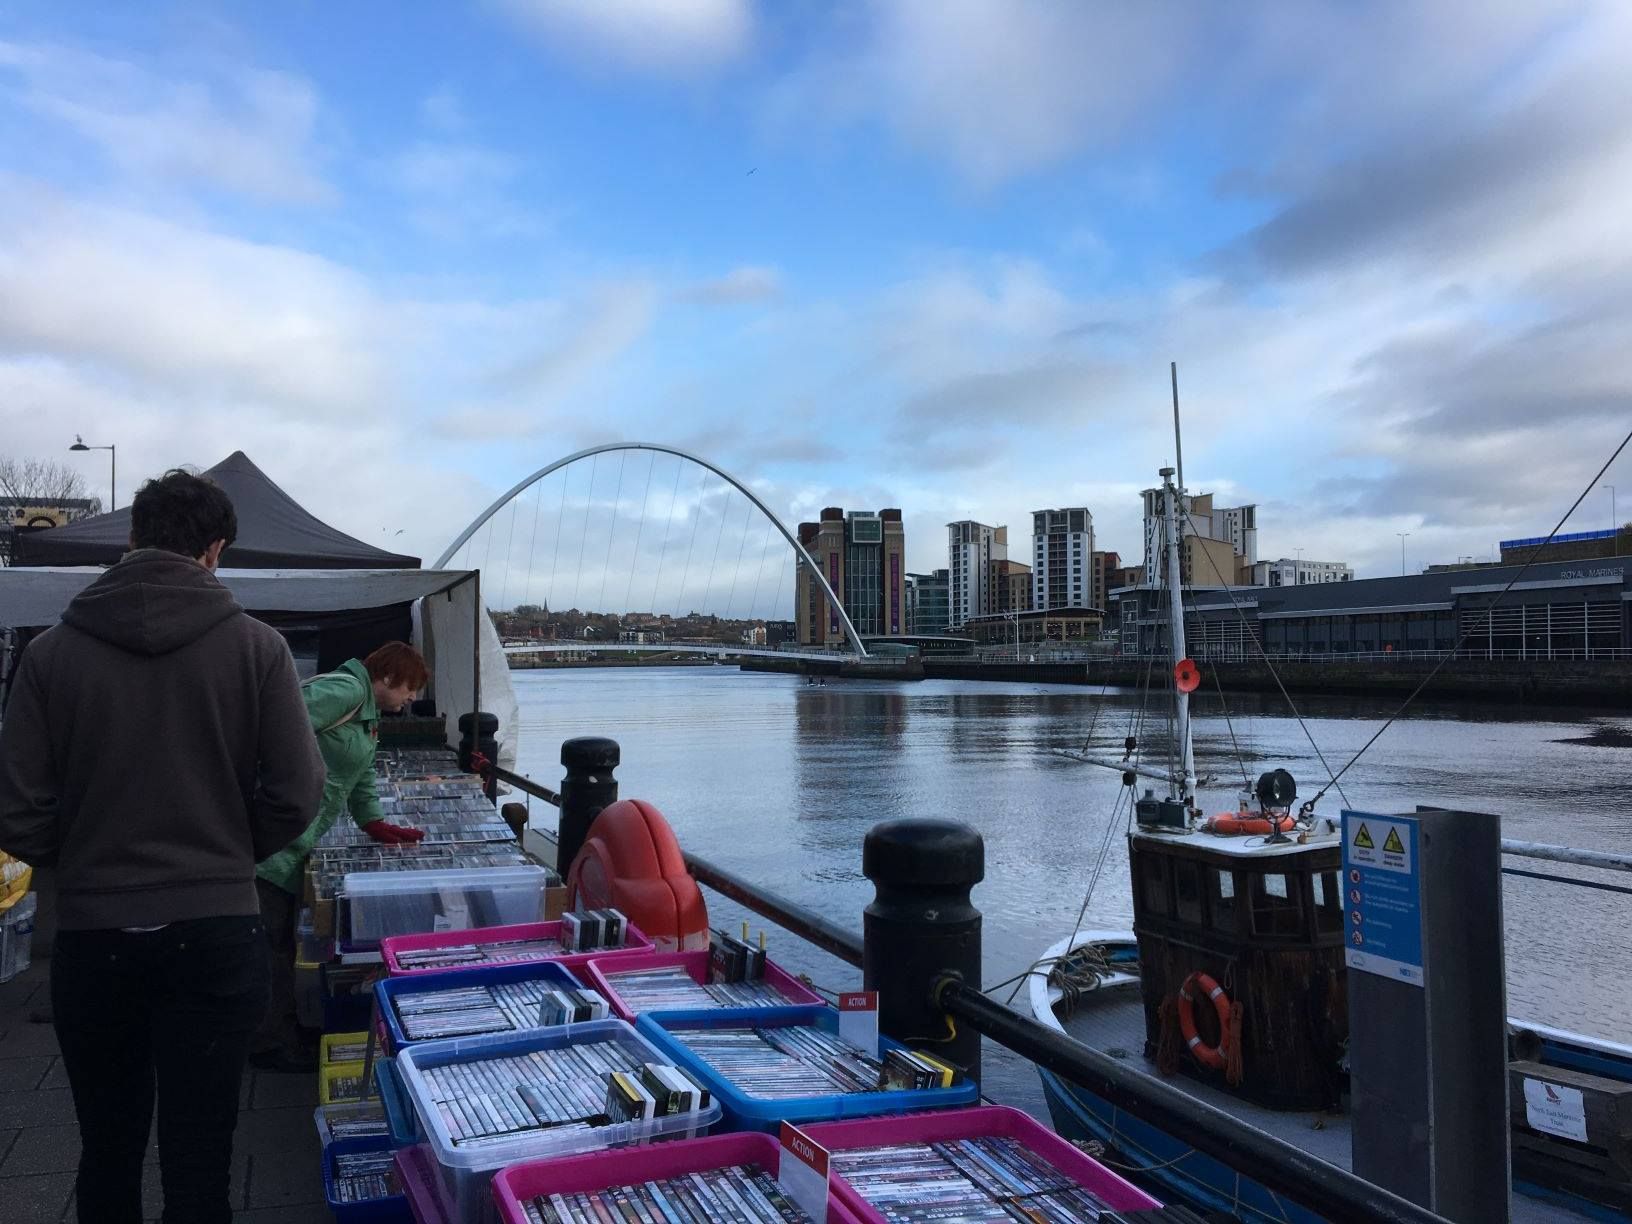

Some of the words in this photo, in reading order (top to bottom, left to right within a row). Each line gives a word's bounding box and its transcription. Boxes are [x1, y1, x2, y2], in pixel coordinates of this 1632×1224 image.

[1560, 569, 1585, 579] ROYAL
[1588, 567, 1625, 577] MARINES
[848, 997, 867, 1007] ACTION
[1530, 1104, 1545, 1114] North
[791, 1136, 815, 1162] ACTION
